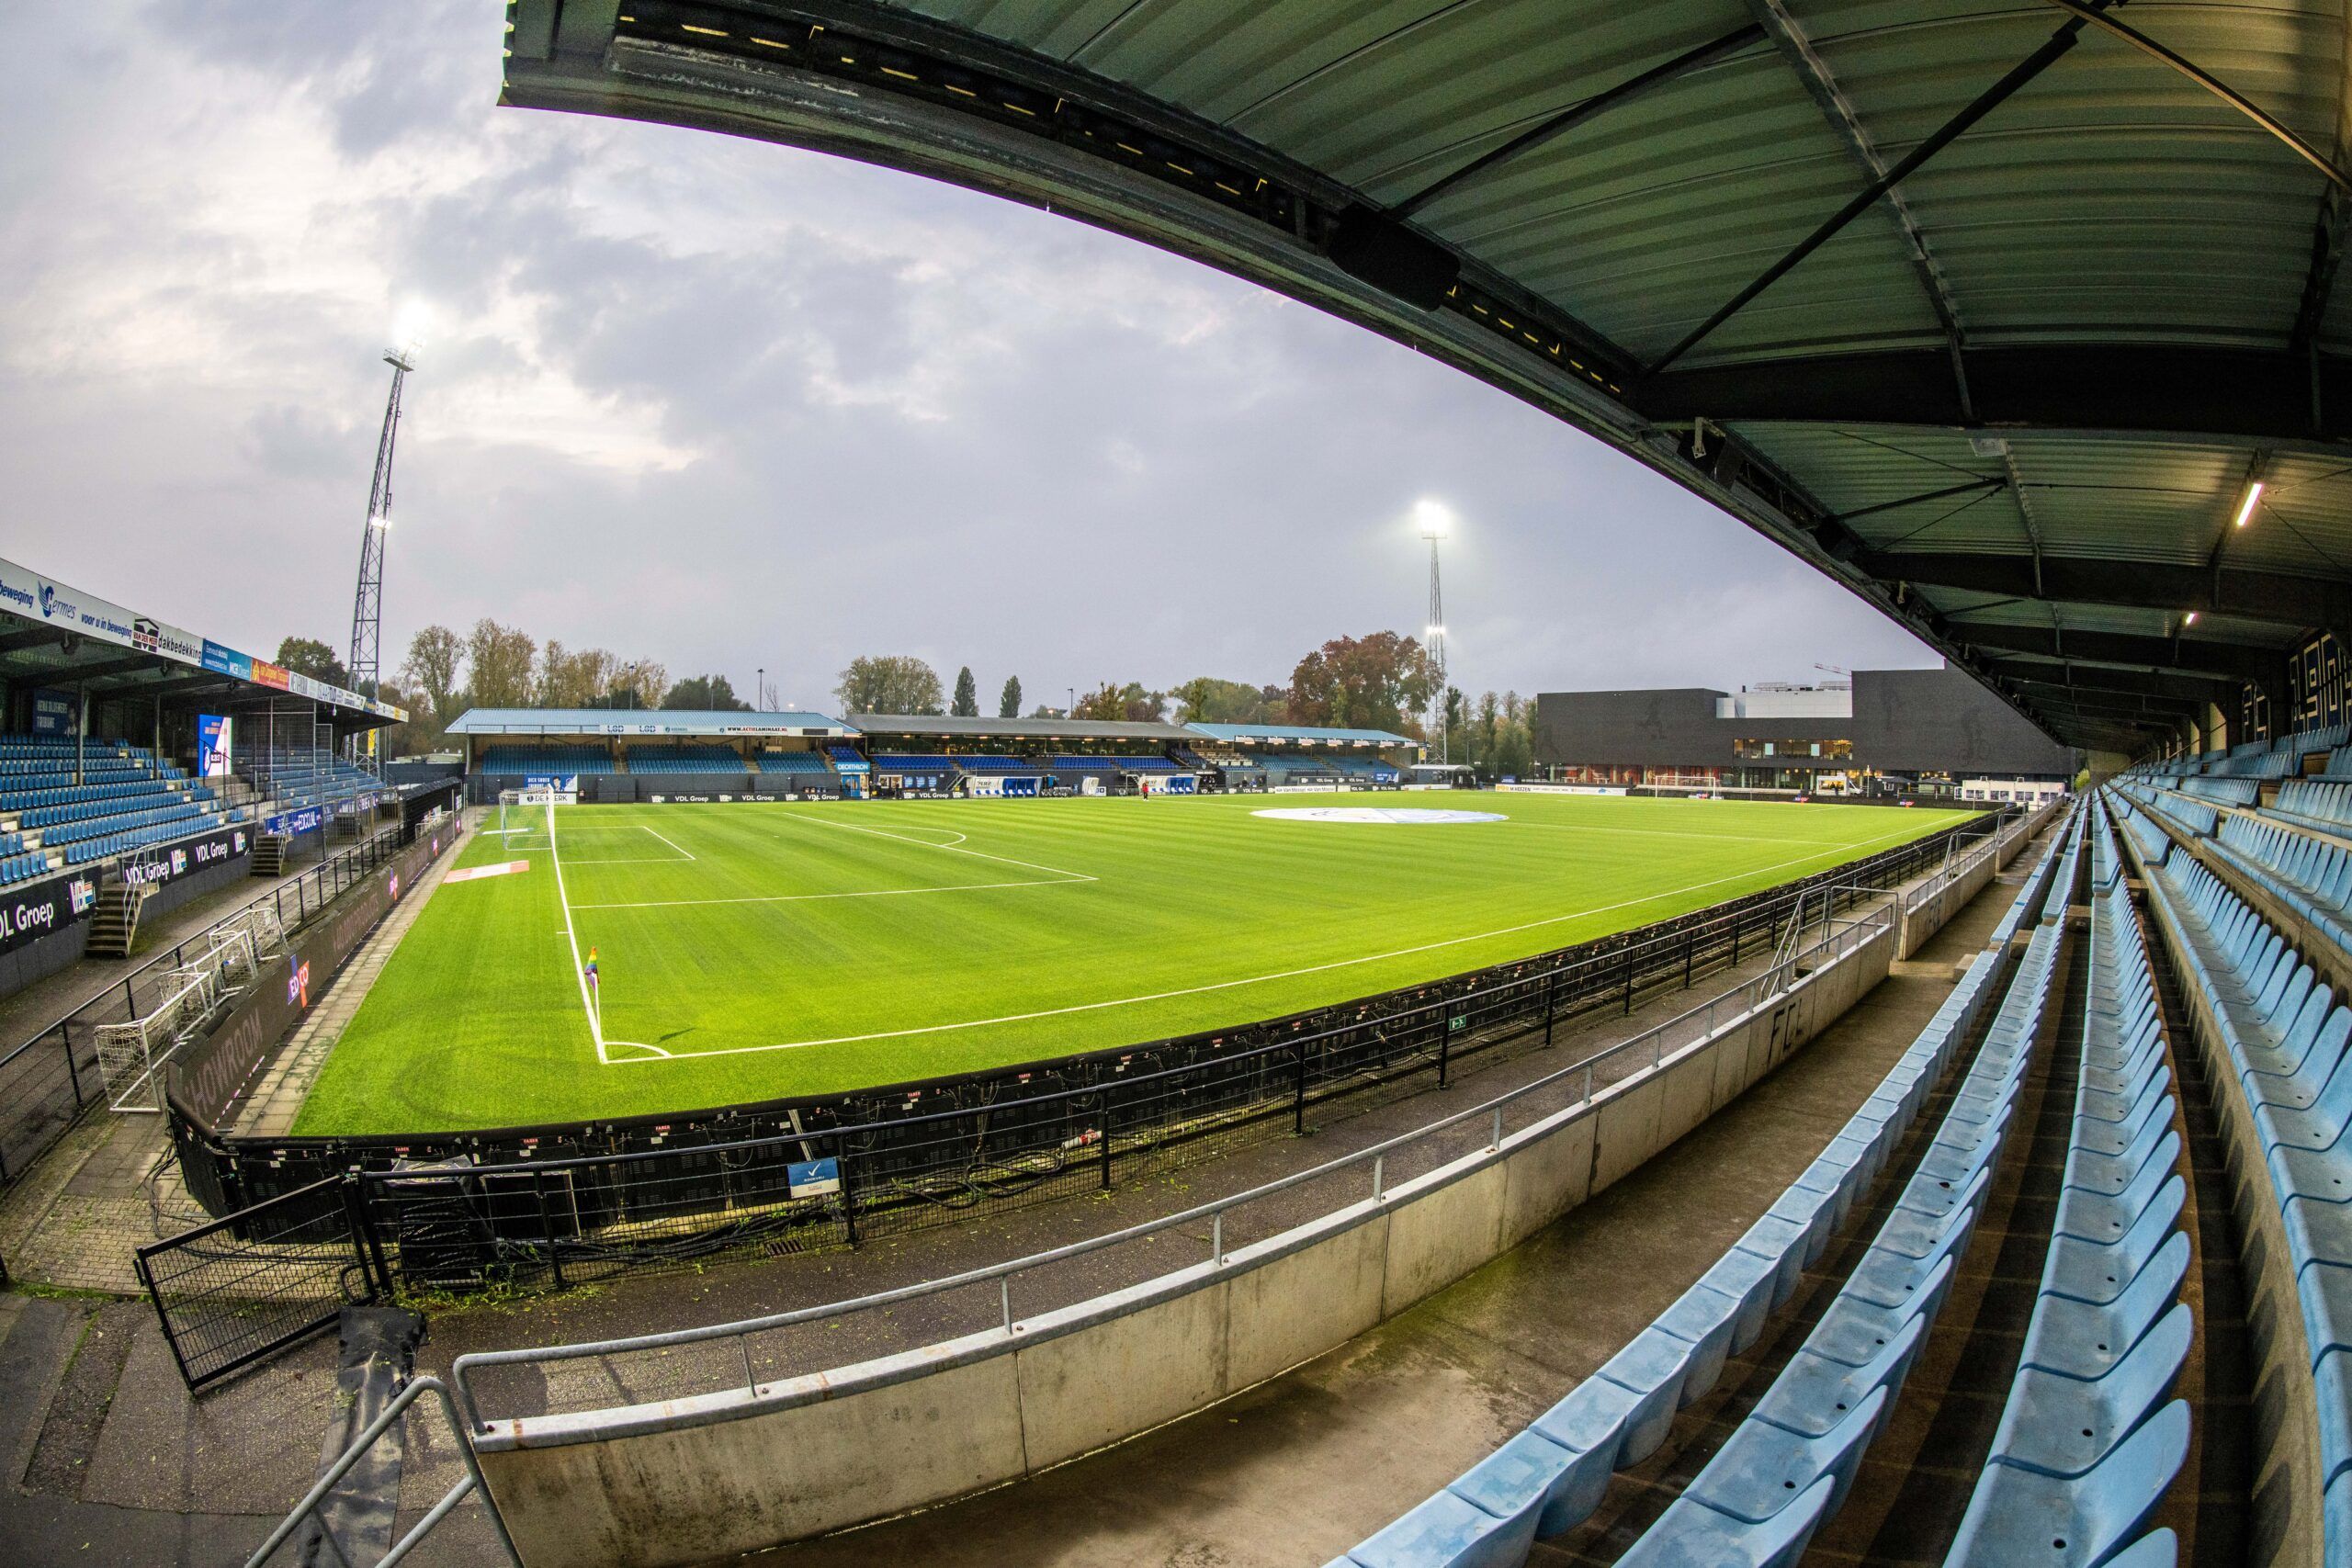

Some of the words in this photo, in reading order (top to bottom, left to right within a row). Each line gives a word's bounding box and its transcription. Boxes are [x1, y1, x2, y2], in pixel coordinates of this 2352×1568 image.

[81, 613, 95, 626] voor
[100, 617, 107, 629] in
[107, 618, 132, 639] beweging
[158, 634, 202, 663] dakbedekking
[196, 845, 209, 863] VDL
[210, 841, 228, 859] Groep
[17, 902, 54, 929] Groep
[288, 965, 309, 998] EDCO
[185, 1007, 263, 1119] HOWROOM
